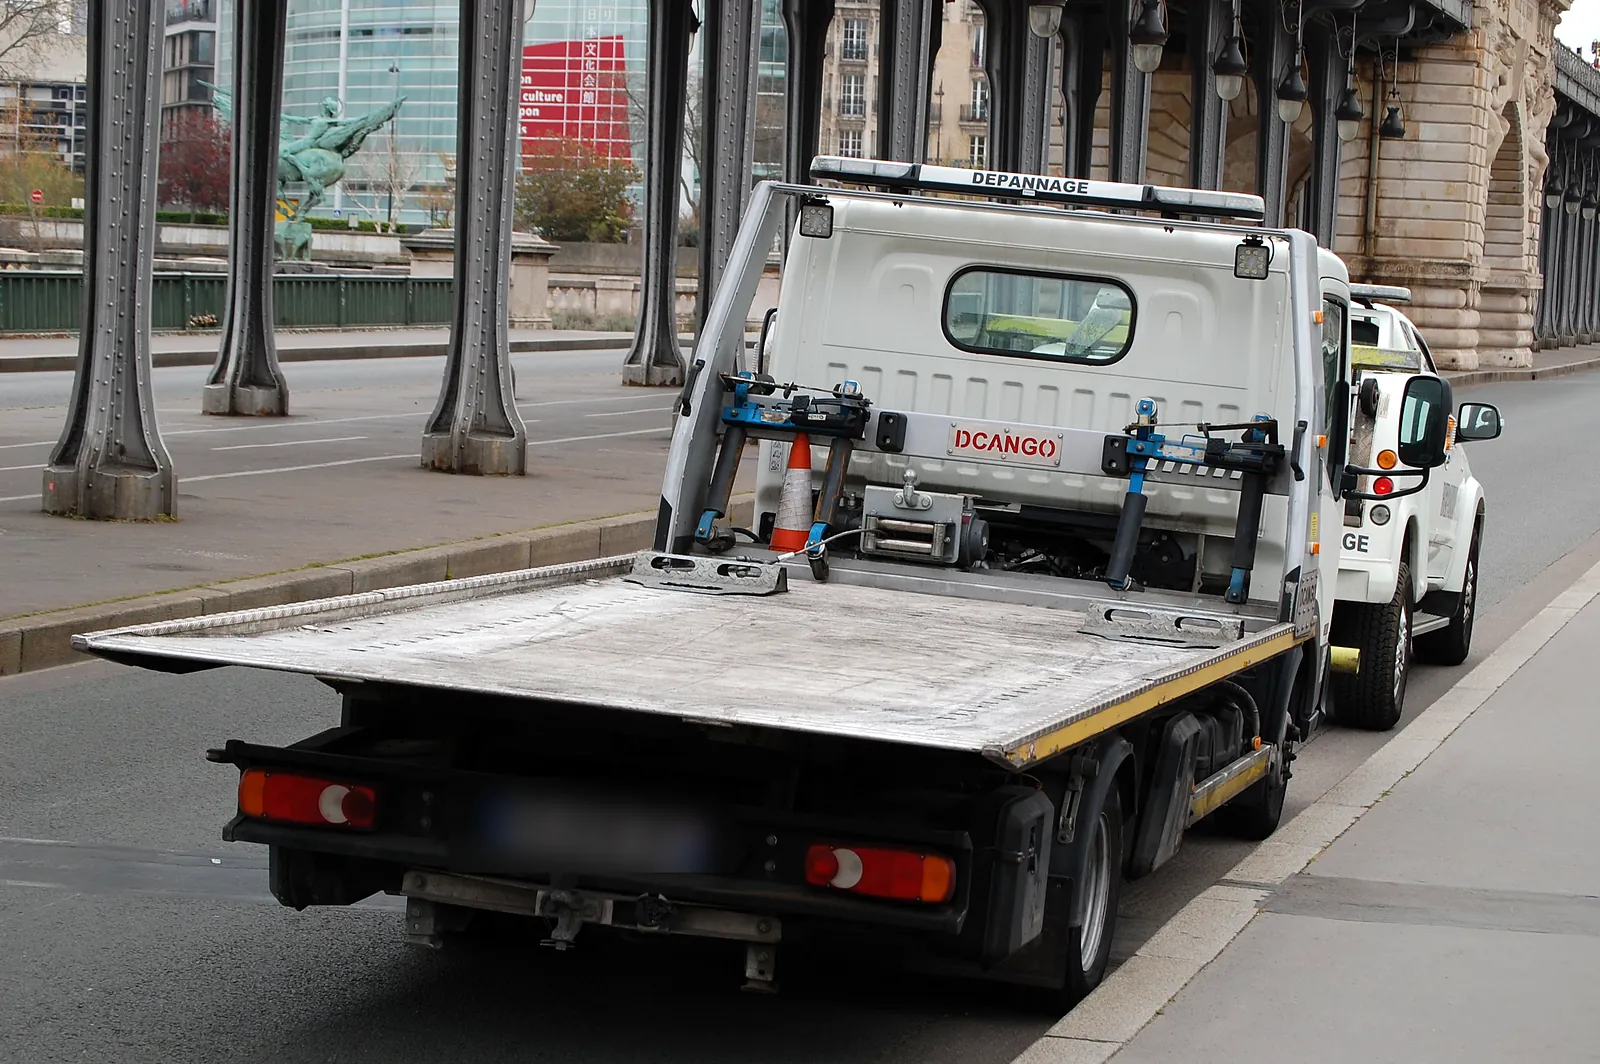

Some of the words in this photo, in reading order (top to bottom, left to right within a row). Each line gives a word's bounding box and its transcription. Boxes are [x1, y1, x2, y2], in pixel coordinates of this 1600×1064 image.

[583, 8, 597, 104] 日本文化会館
[522, 90, 564, 102] culture
[519, 107, 540, 118] pon
[972, 171, 1089, 194] DEPANNAGE
[954, 429, 1056, 458] DCANGO
[1340, 532, 1369, 553] GE
